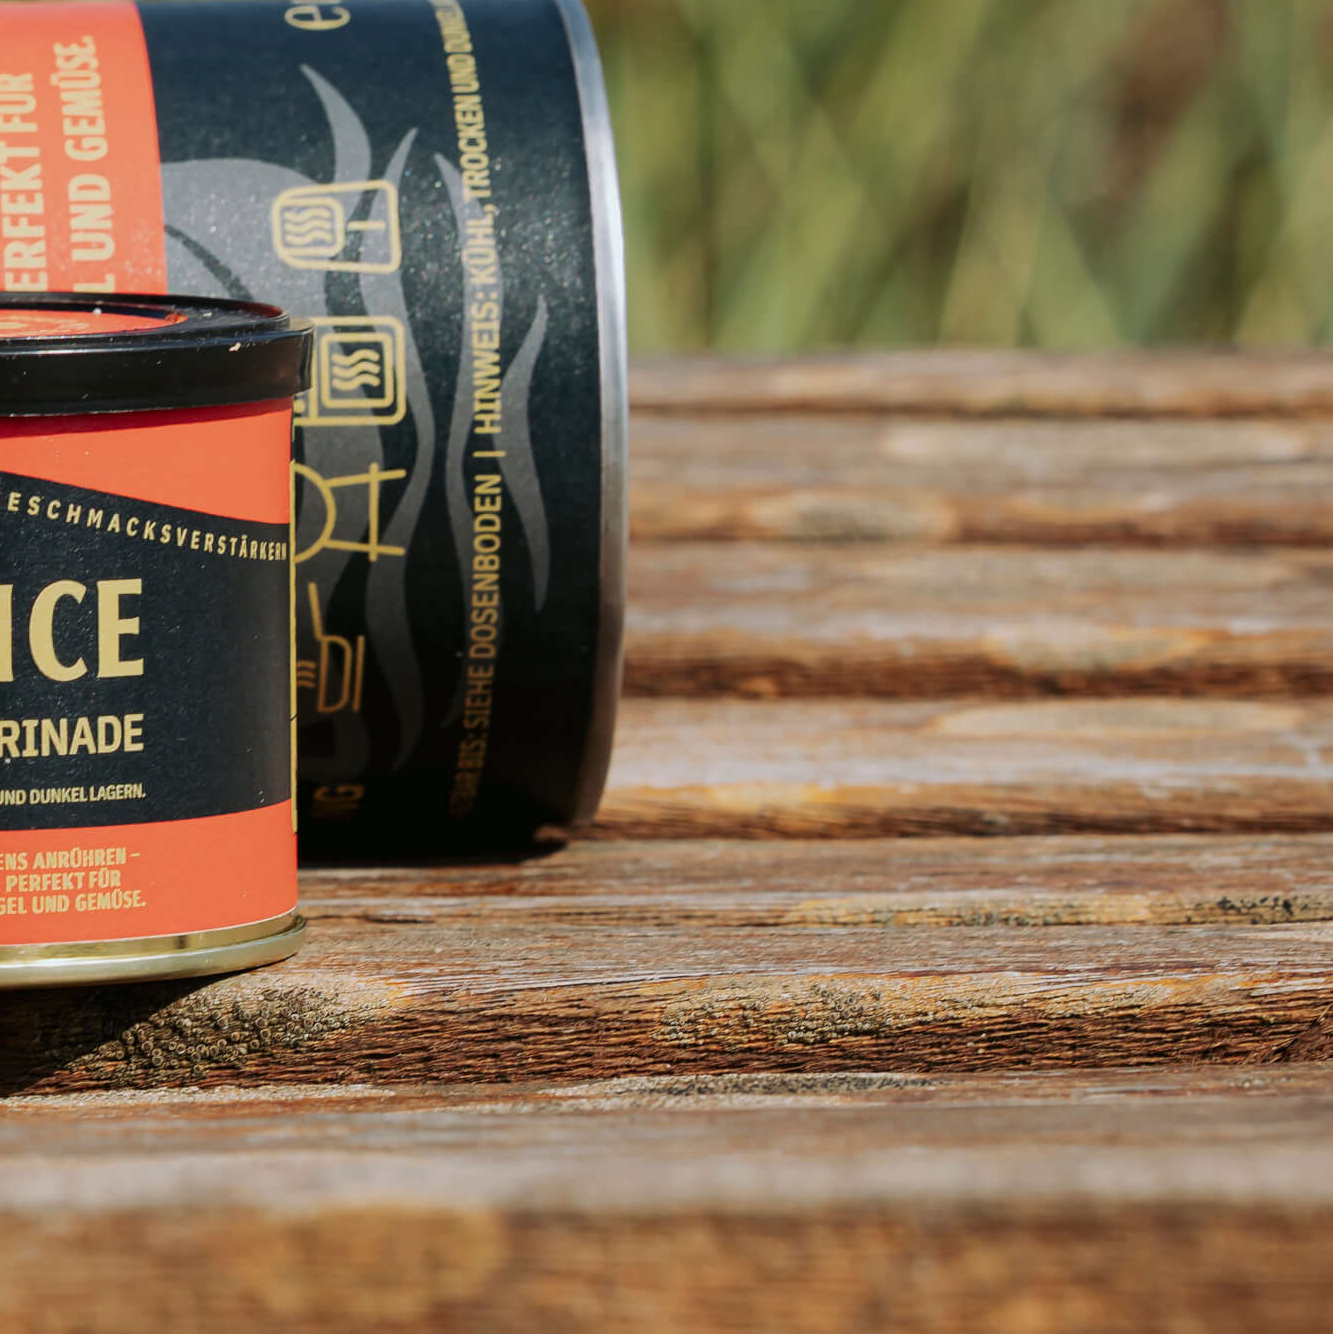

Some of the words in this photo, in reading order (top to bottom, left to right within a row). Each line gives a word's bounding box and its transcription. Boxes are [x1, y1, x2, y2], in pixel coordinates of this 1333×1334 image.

[50, 35, 110, 162] GEMÜSE.
[446, 53, 481, 94] UND
[452, 93, 493, 201] TROCKEN
[68, 173, 116, 262] UND
[461, 203, 498, 286] KÜHL,
[470, 291, 503, 435] HINWEIS:
[468, 473, 503, 659] DOSENBODEN
[29, 785, 87, 804] DUNKEL
[89, 782, 147, 802] LAGERN.
[5, 870, 86, 893] PERFEKT
[88, 867, 122, 889] FÜR
[32, 846, 127, 870] ANRÜHREN
[31, 894, 70, 914] UND
[74, 888, 147, 913] GEMÜSE.
